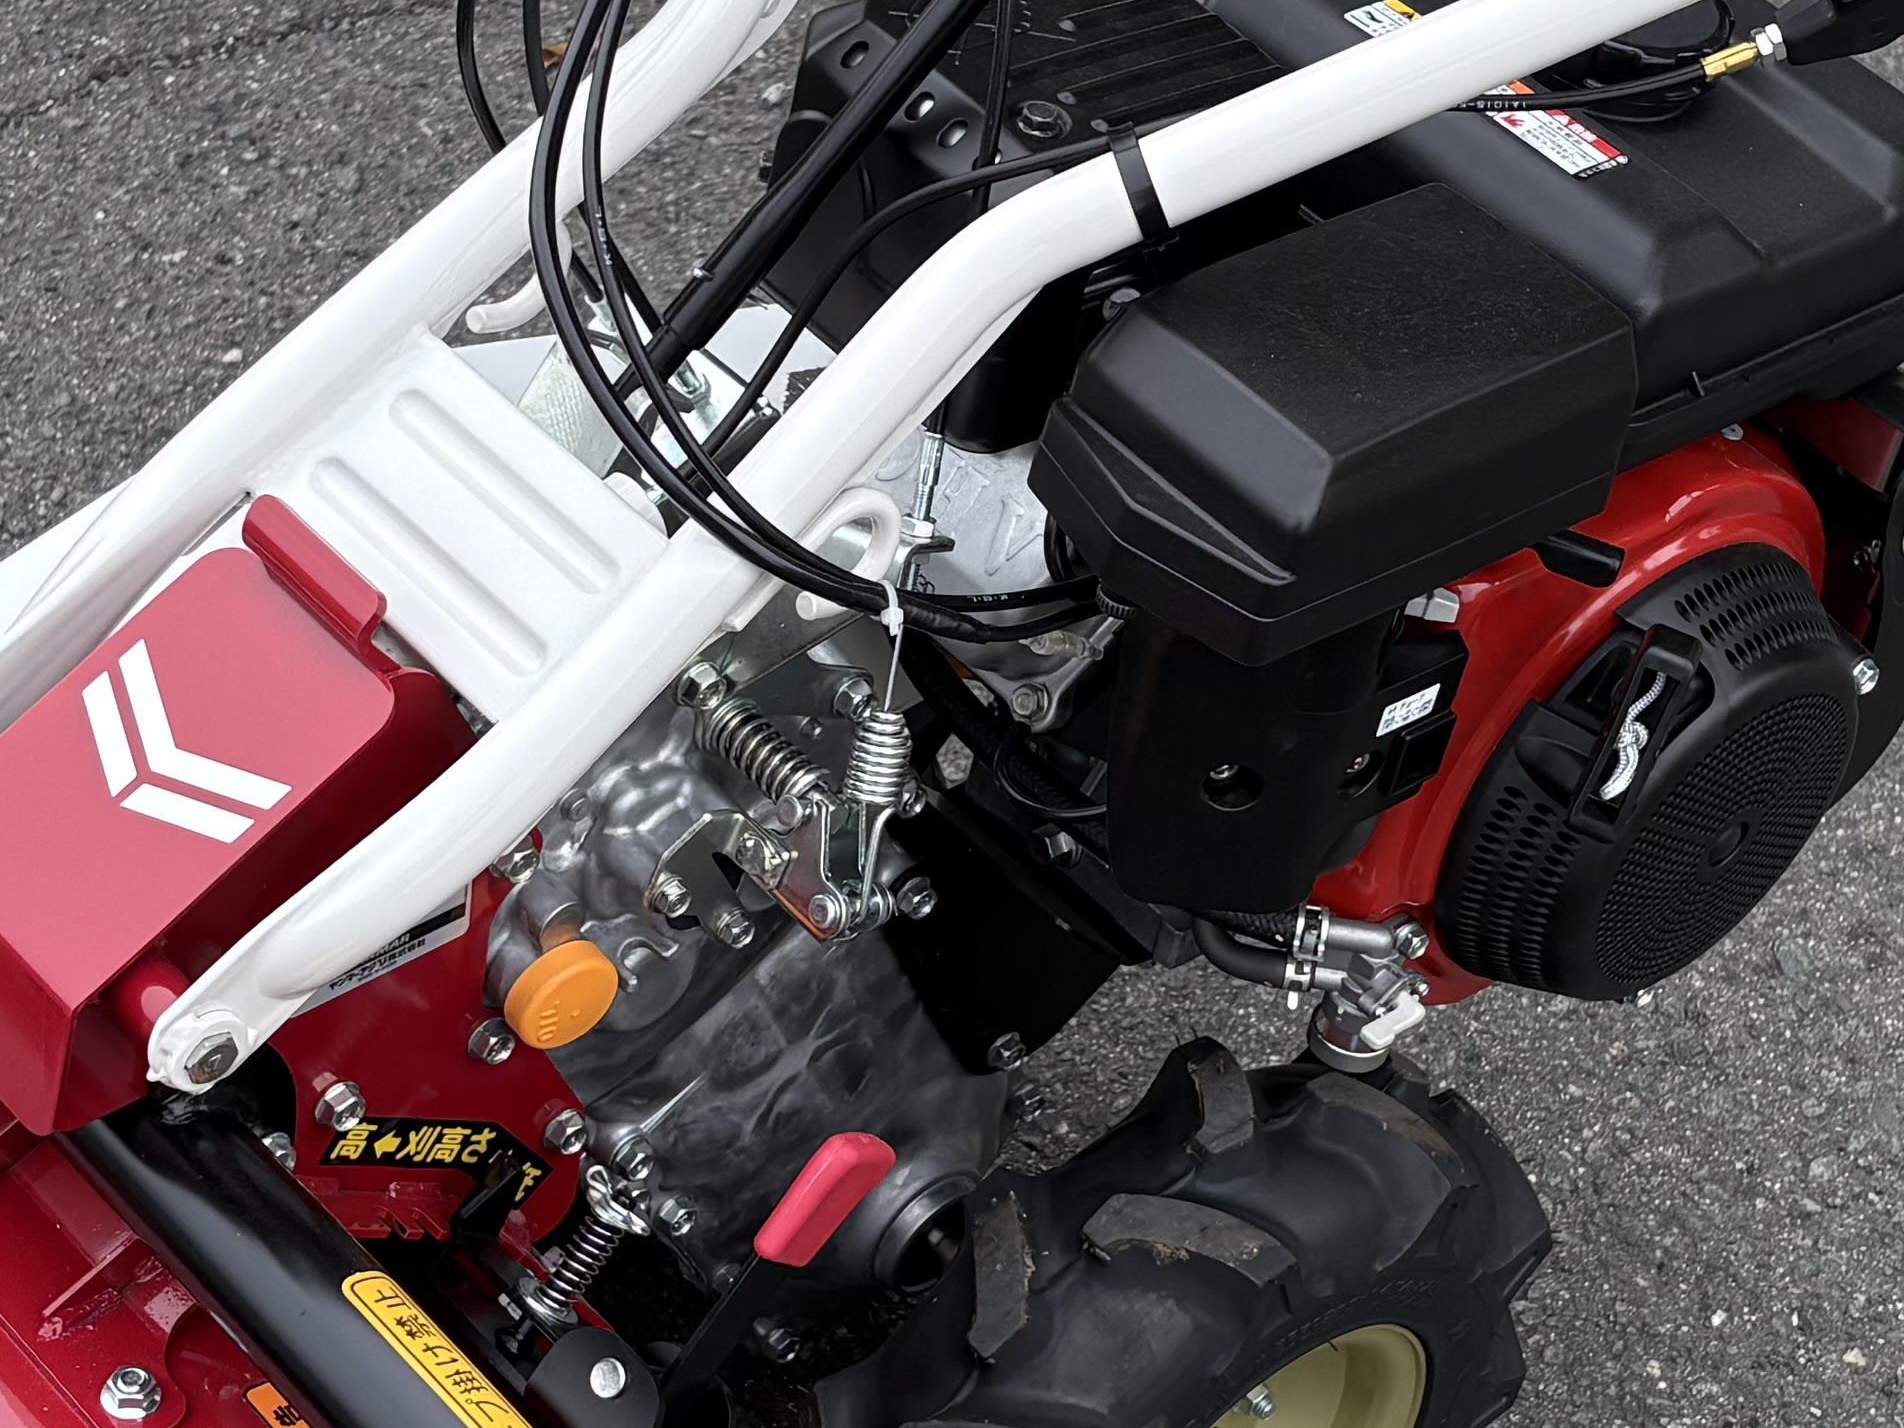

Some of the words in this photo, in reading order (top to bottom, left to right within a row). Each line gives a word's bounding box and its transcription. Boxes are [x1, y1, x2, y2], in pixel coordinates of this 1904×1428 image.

[330, 1122, 379, 1161] 高
[395, 1125, 497, 1164] 刈高さ
